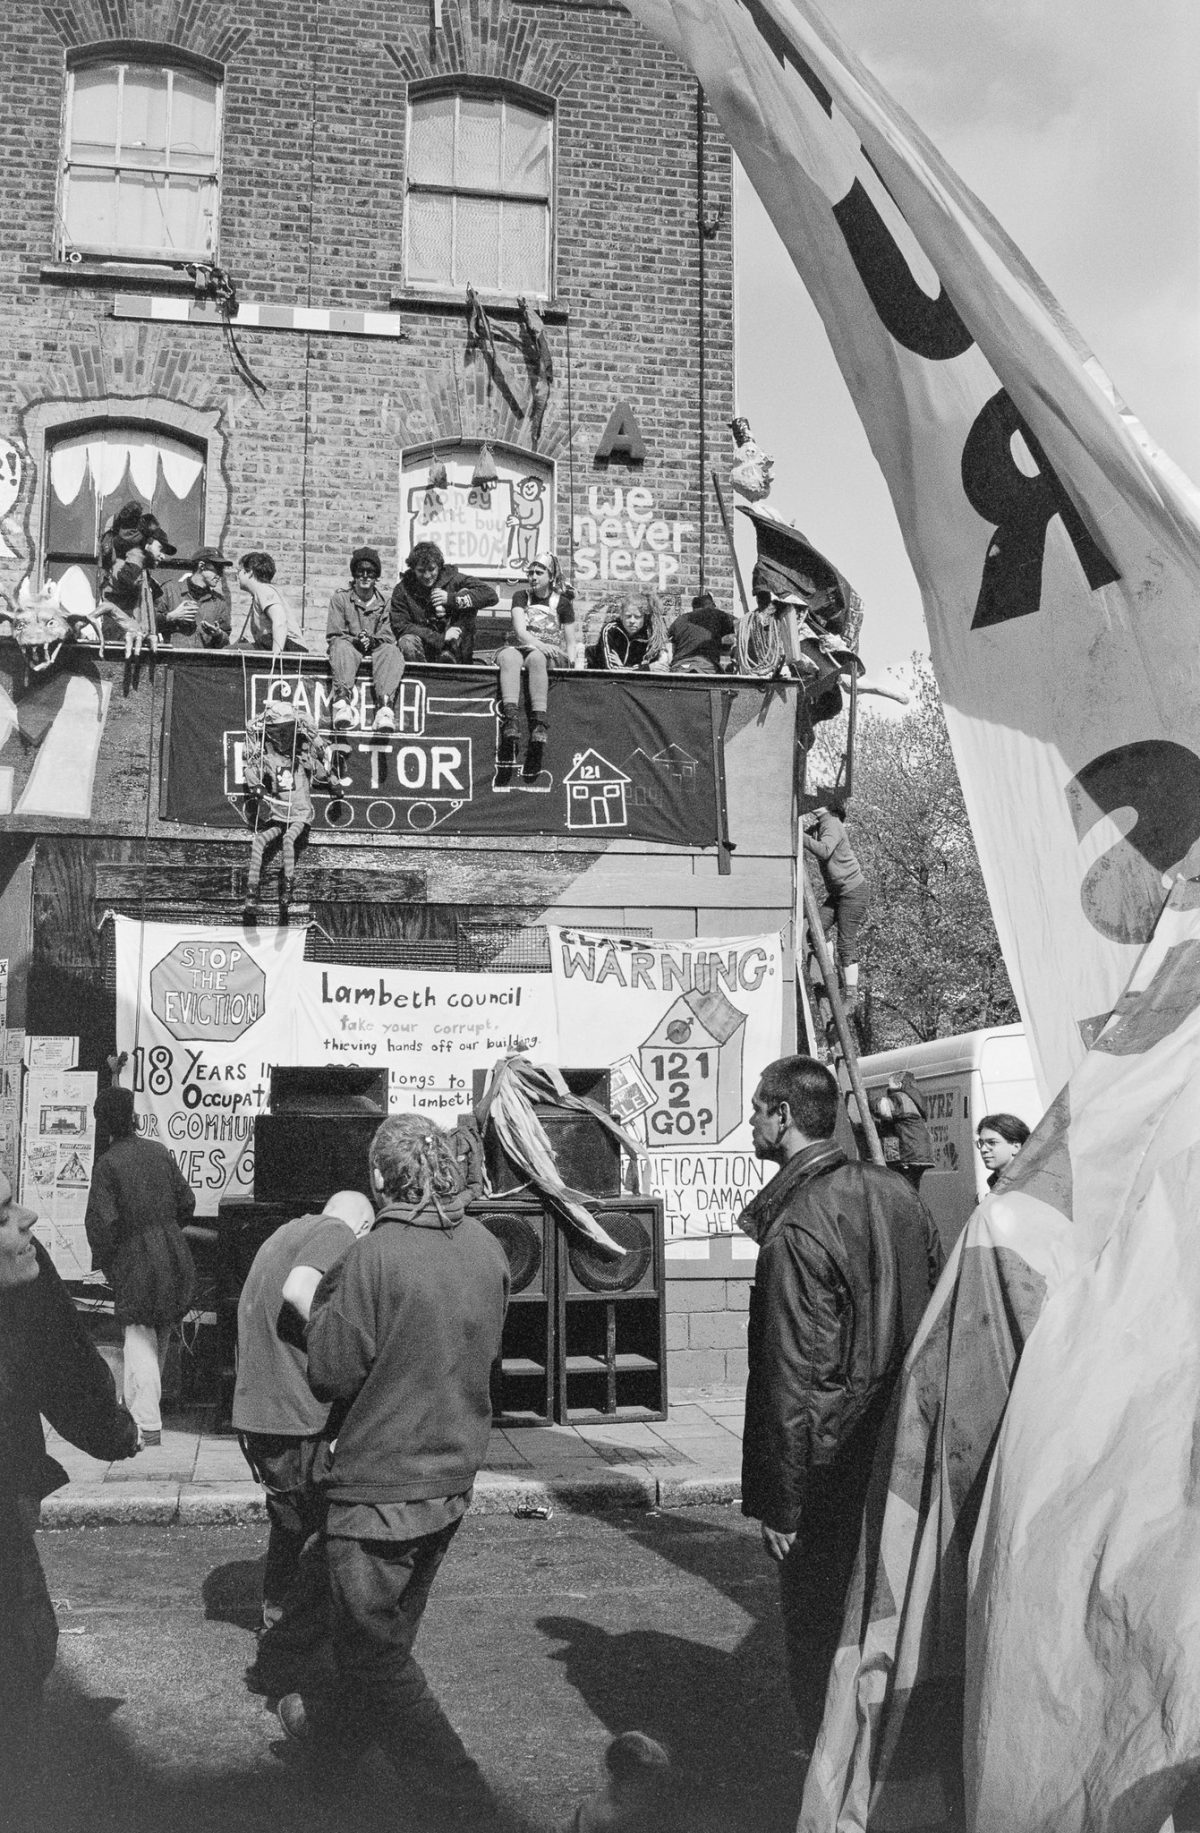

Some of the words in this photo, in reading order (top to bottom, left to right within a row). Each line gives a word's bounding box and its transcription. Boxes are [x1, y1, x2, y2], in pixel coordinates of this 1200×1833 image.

[588, 486, 653, 523] we
[475, 509, 506, 546] buy
[573, 516, 694, 553] never
[574, 546, 680, 592] sleep
[581, 765, 600, 779] 121
[181, 948, 242, 972] STOP
[187, 969, 229, 990] THE
[165, 991, 259, 1025] EVICTION
[447, 987, 522, 1007] council
[382, 1021, 418, 1034] your
[324, 1038, 377, 1056] thieving
[388, 1038, 422, 1052] hands
[431, 1040, 453, 1053] off
[459, 1041, 479, 1051] our
[132, 1045, 173, 1096] 18
[449, 1074, 466, 1089] to
[669, 1081, 690, 1109] 2
[651, 1108, 713, 1136] GO?
